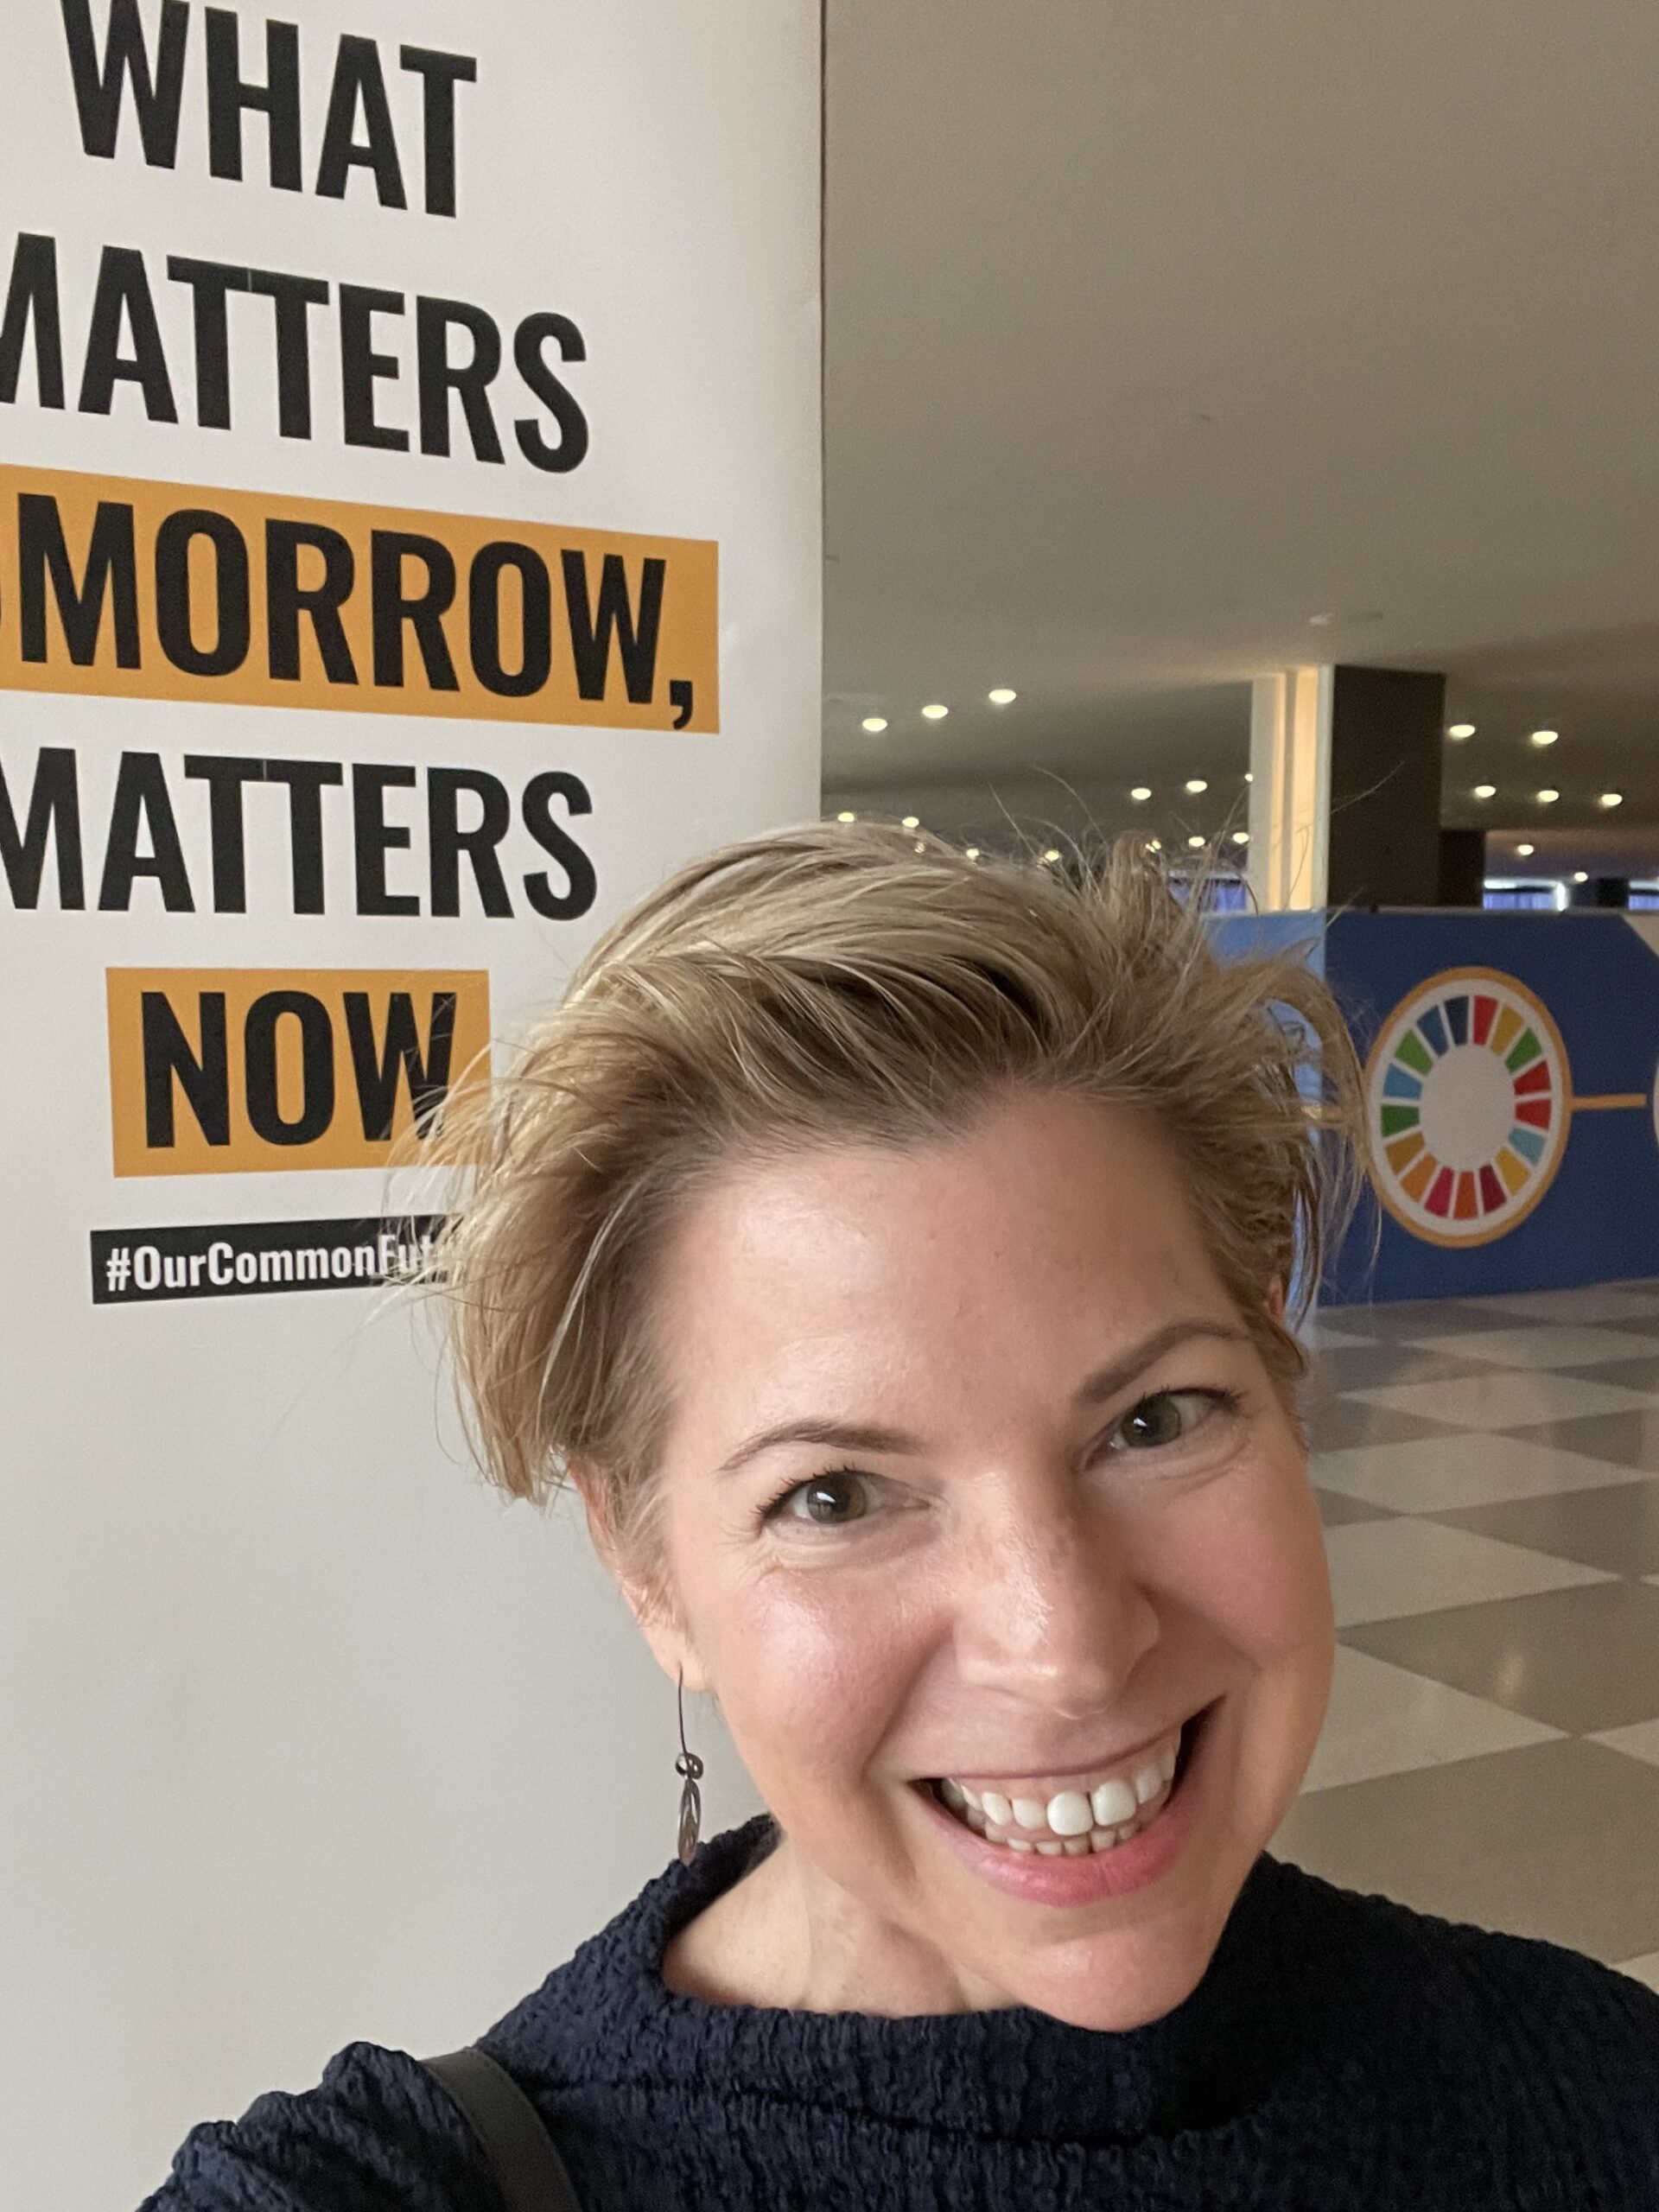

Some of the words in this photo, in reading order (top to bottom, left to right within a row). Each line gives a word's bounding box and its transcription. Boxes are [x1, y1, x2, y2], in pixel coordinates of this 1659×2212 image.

[60, 0, 476, 217] WHAT
[0, 493, 693, 730] MORROW,
[0, 747, 597, 921] MATTERS
[141, 990, 457, 1147] NOW
[105, 1233, 435, 1292] #OurCommonFut
